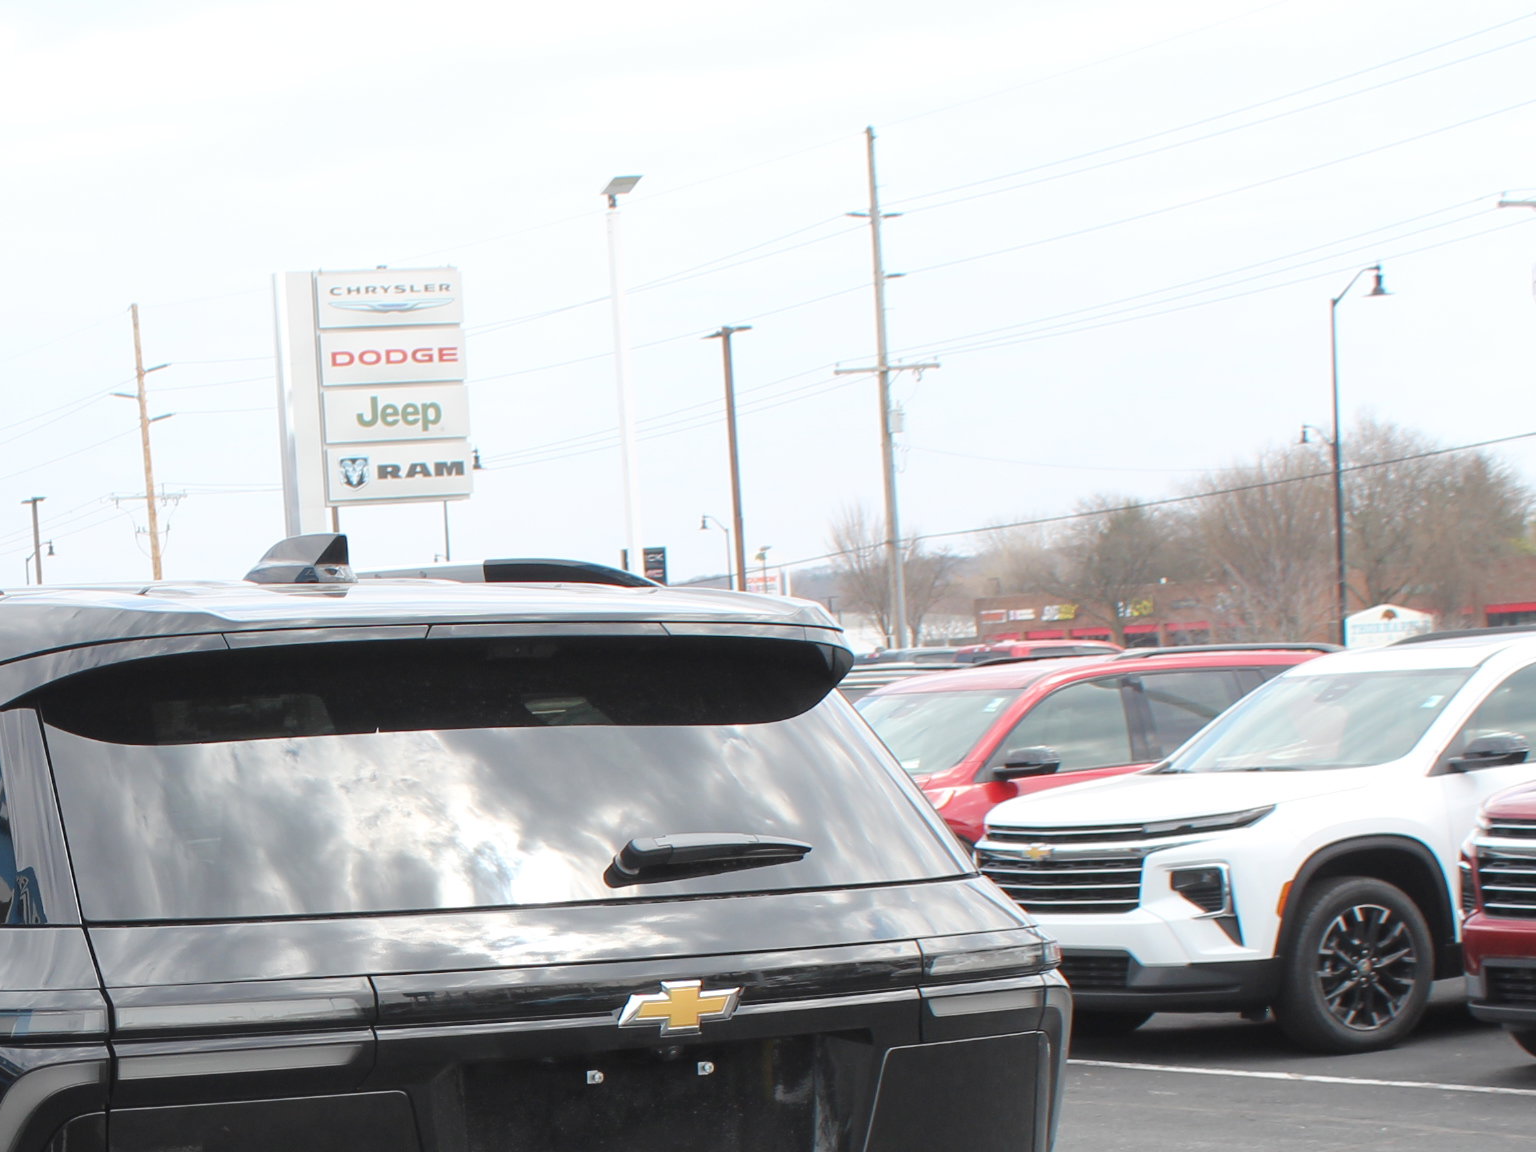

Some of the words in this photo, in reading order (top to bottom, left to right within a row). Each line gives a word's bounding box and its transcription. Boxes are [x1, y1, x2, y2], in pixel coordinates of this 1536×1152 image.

[329, 283, 452, 296] CHRYSLER
[331, 347, 459, 367] DODGE
[356, 396, 443, 432] Jeep
[377, 461, 465, 480] RAM
